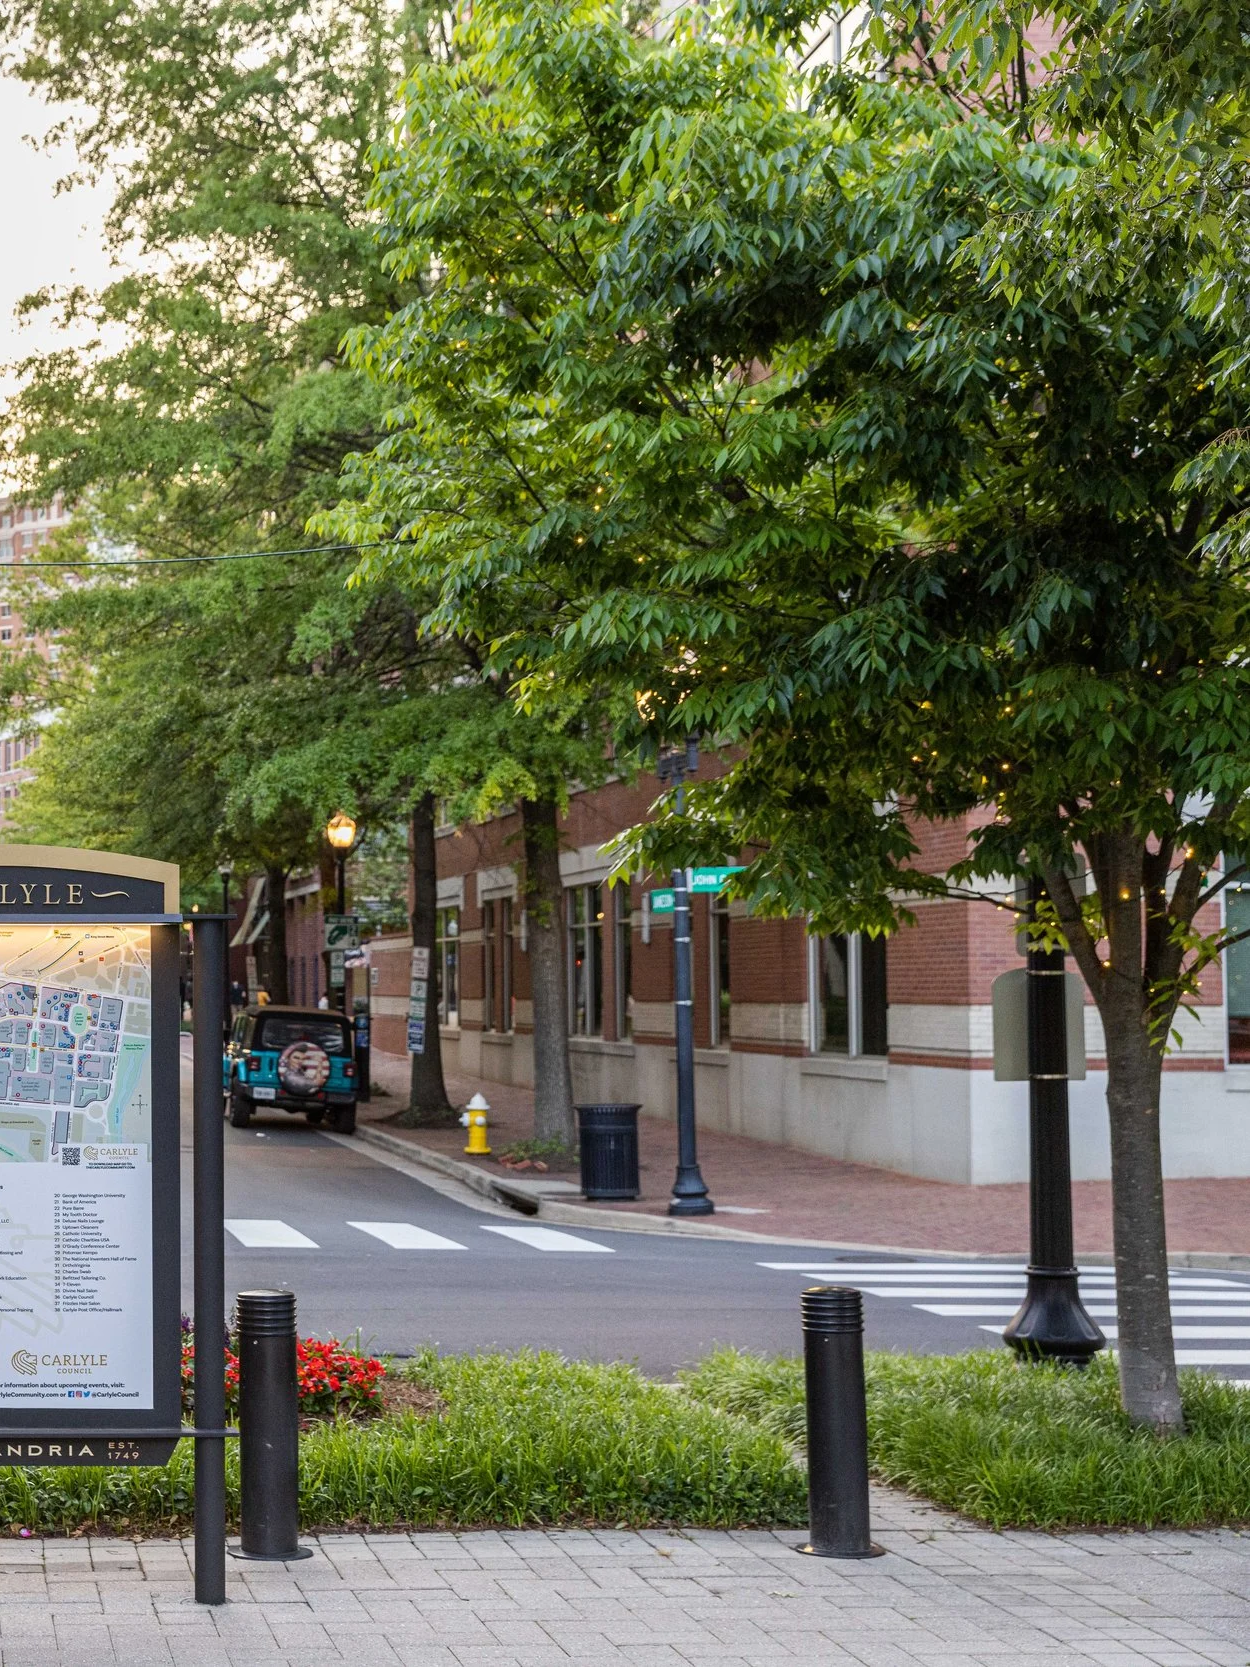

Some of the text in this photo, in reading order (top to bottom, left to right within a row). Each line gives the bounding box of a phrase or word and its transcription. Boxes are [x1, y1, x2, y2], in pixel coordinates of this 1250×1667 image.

[692, 874, 717, 885] JOHN
[41, 1355, 108, 1366] CARLYLE
[107, 1452, 140, 1460] 1749
